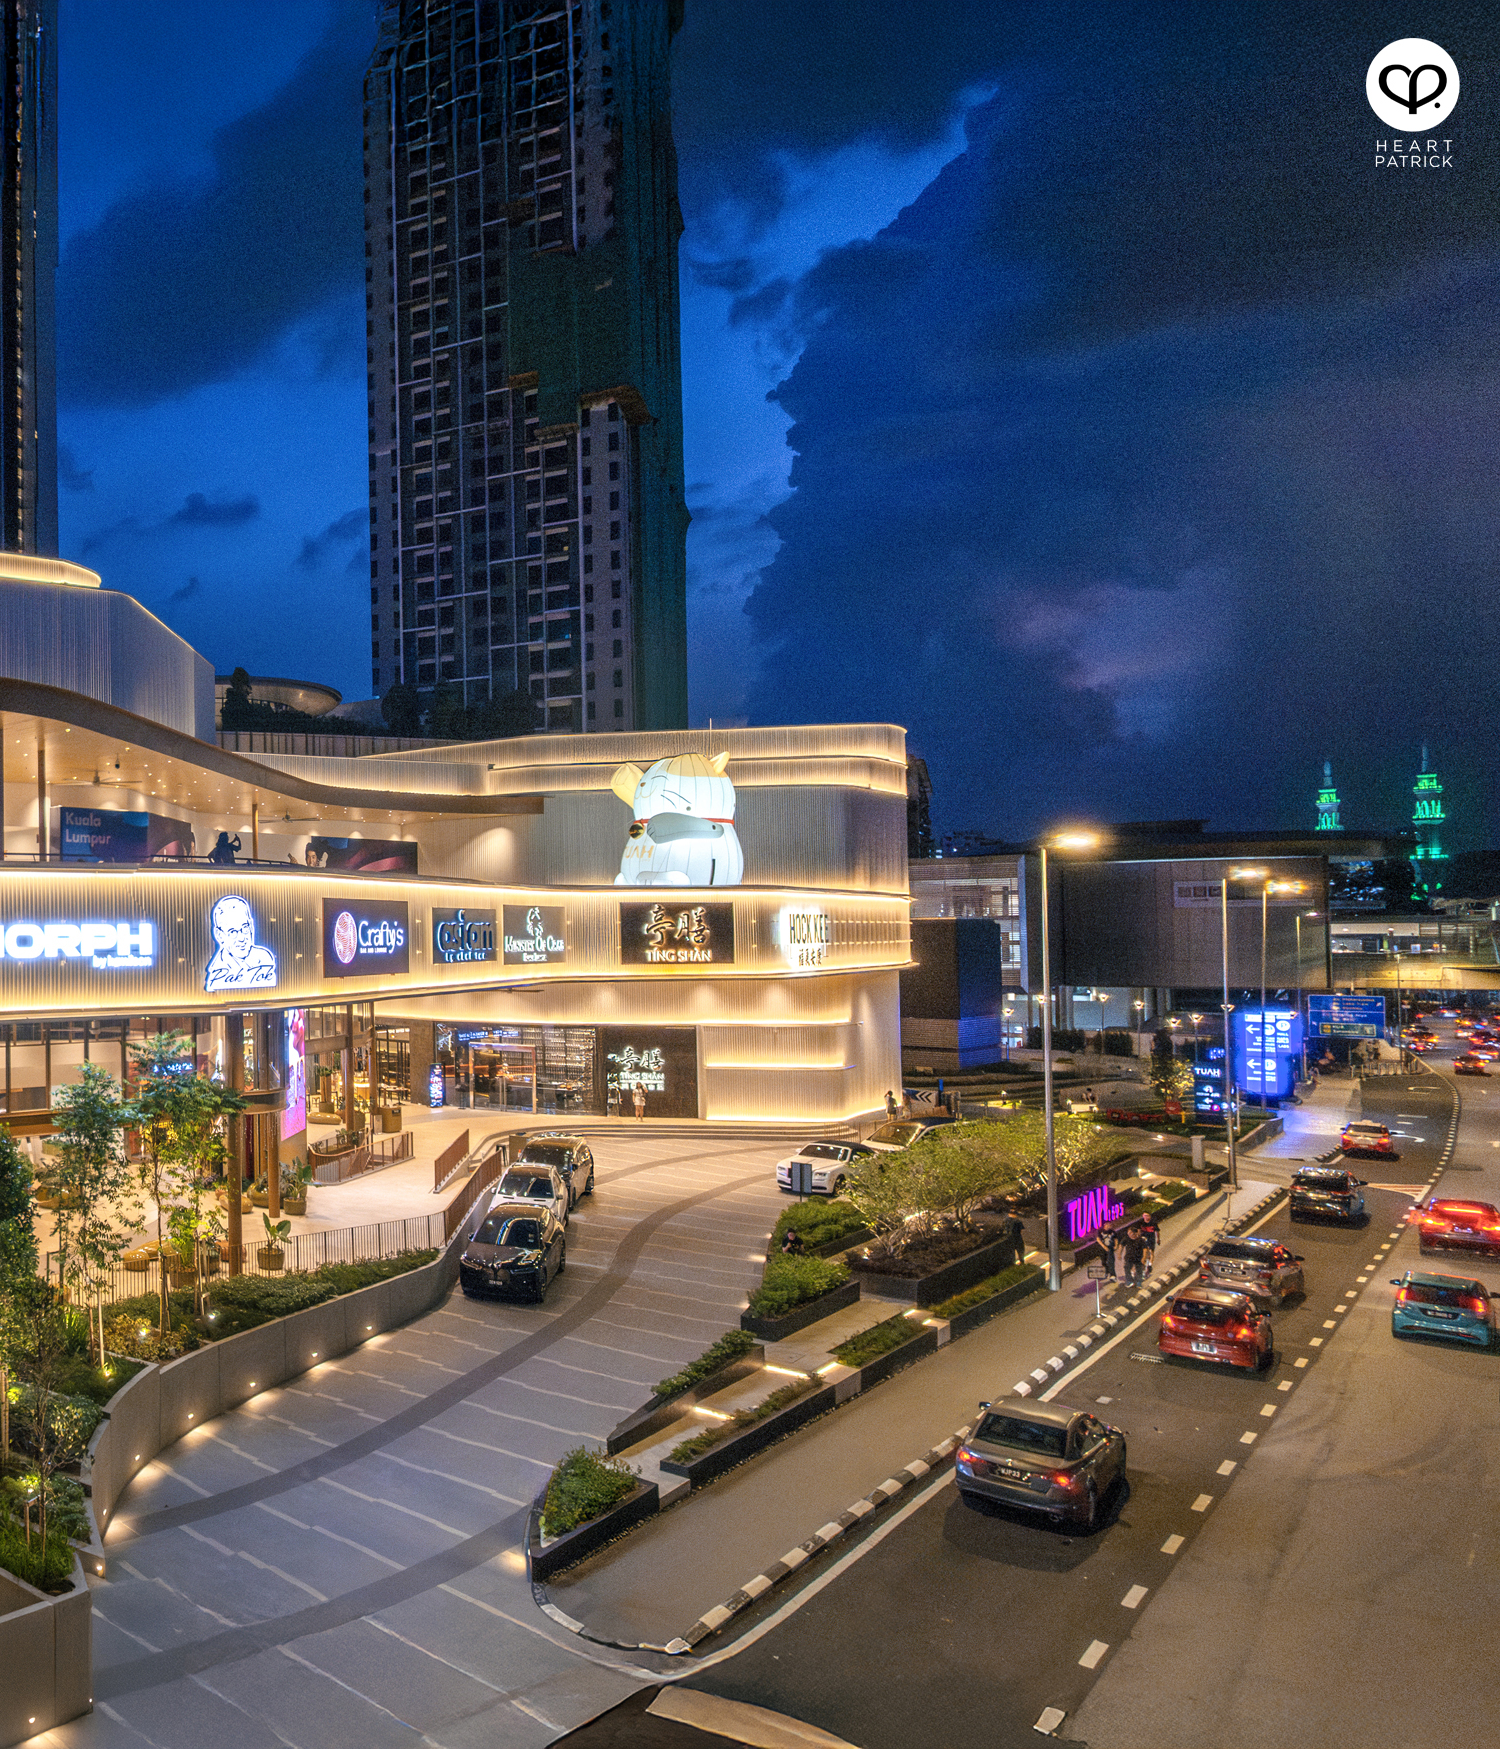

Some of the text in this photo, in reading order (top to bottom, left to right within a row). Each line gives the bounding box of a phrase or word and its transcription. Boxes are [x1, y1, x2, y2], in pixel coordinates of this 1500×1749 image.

[65, 811, 102, 828] Kuala
[65, 828, 112, 848] Lumpur
[358, 920, 404, 955] Crafty's
[789, 913, 829, 944] HOCK KEE
[209, 967, 244, 987] Pak
[1193, 1067, 1221, 1077] TUAH
[1067, 1184, 1108, 1241] TUAH
